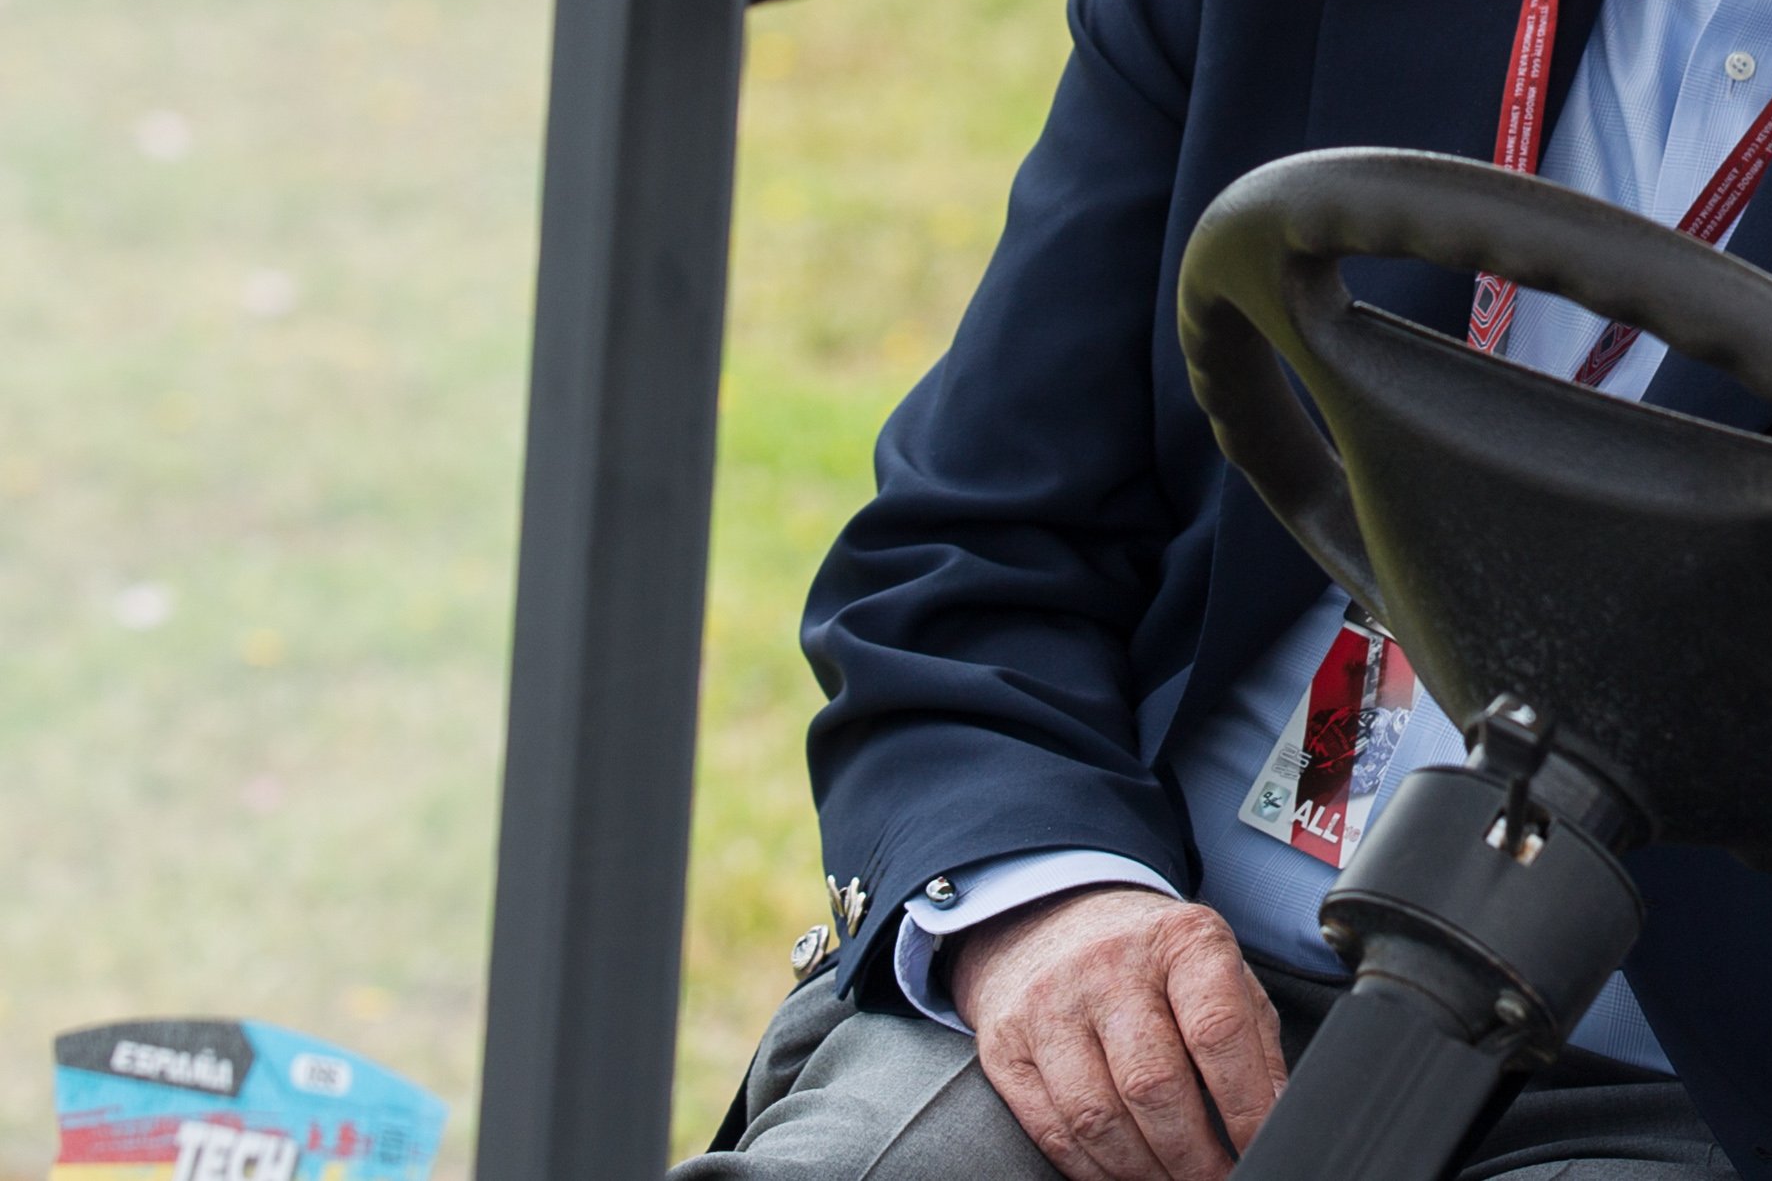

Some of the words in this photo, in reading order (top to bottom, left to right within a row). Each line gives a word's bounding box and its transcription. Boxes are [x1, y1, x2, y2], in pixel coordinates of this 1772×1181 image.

[1716, 165, 1741, 195] RAINEY
[1292, 799, 1341, 844] ALL
[110, 1039, 234, 1094] ESPAÑA
[170, 1120, 300, 1181] TECH
